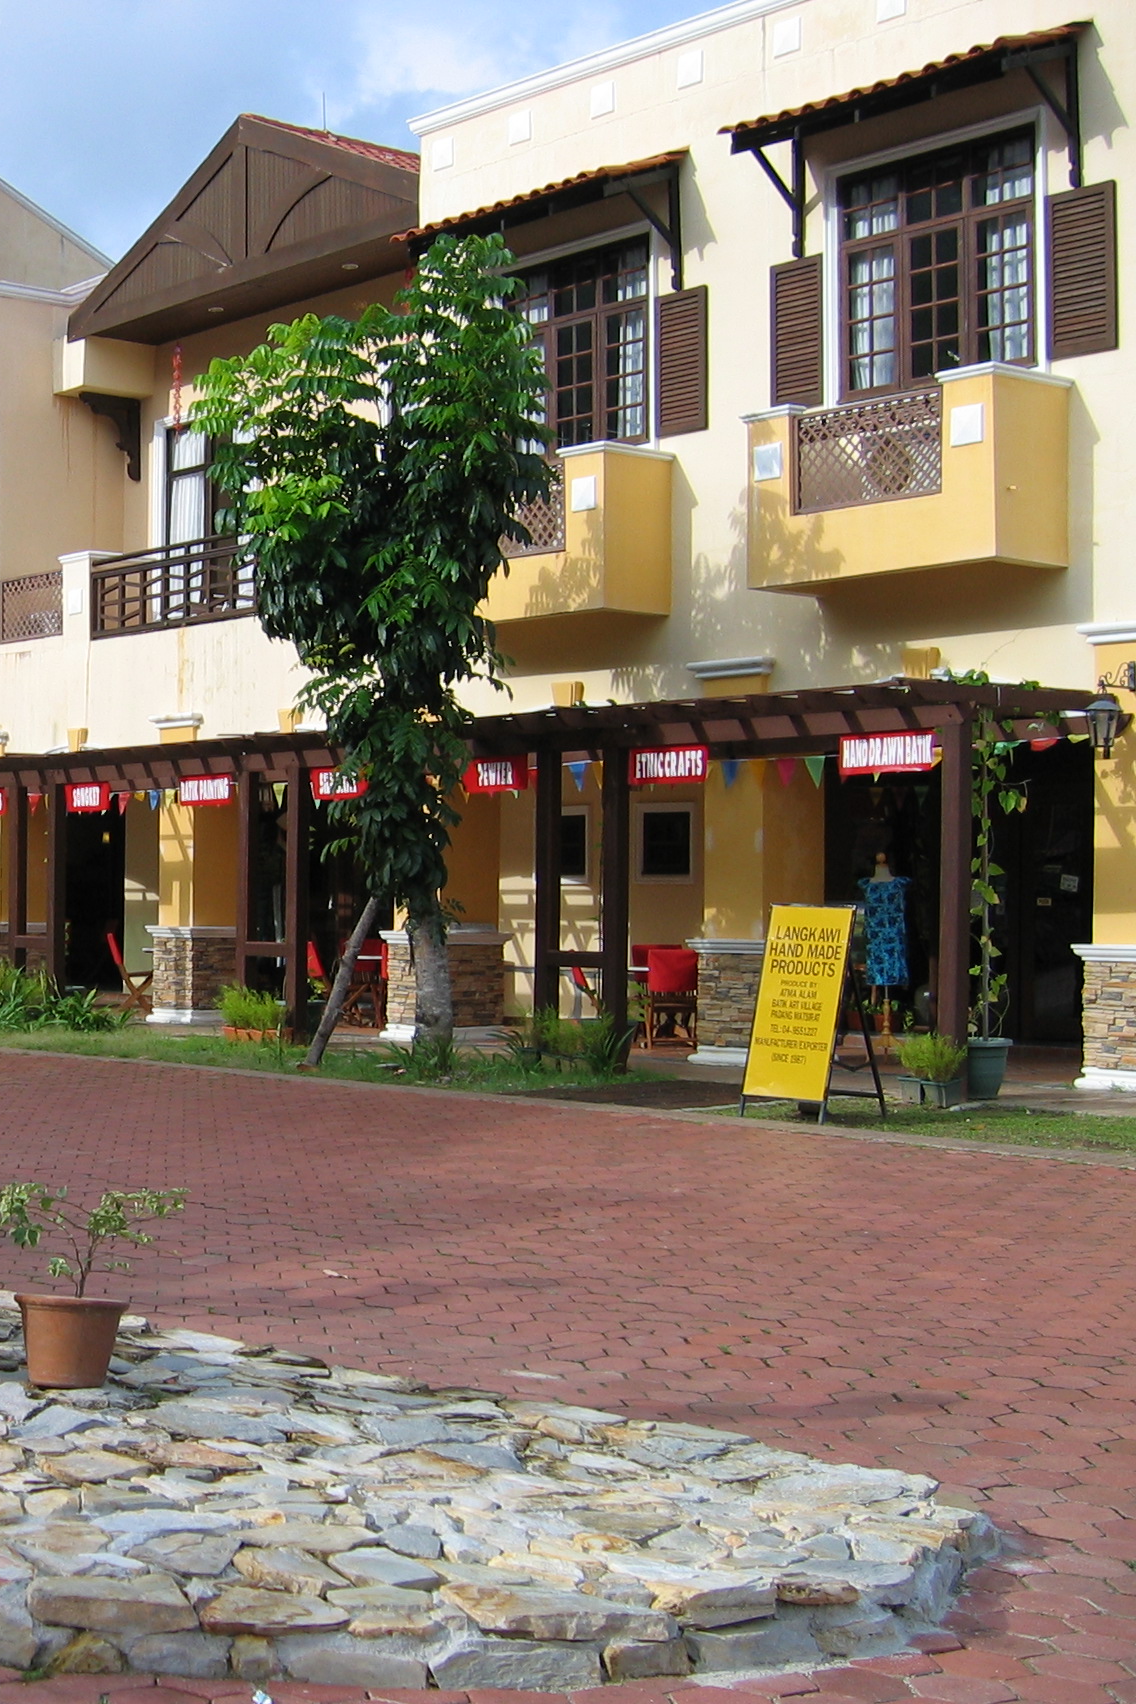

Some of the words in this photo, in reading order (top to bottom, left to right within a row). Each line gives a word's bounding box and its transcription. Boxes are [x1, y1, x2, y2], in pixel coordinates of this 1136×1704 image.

[843, 739, 869, 768] HAND
[869, 736, 904, 767] DRAWN
[905, 734, 932, 765] BATIK
[664, 749, 703, 777] CRAFTS
[775, 926, 840, 942] LANGKAWI
[769, 943, 804, 958] HAND
[807, 945, 842, 960] MADE
[770, 959, 836, 977] PRODUCTS
